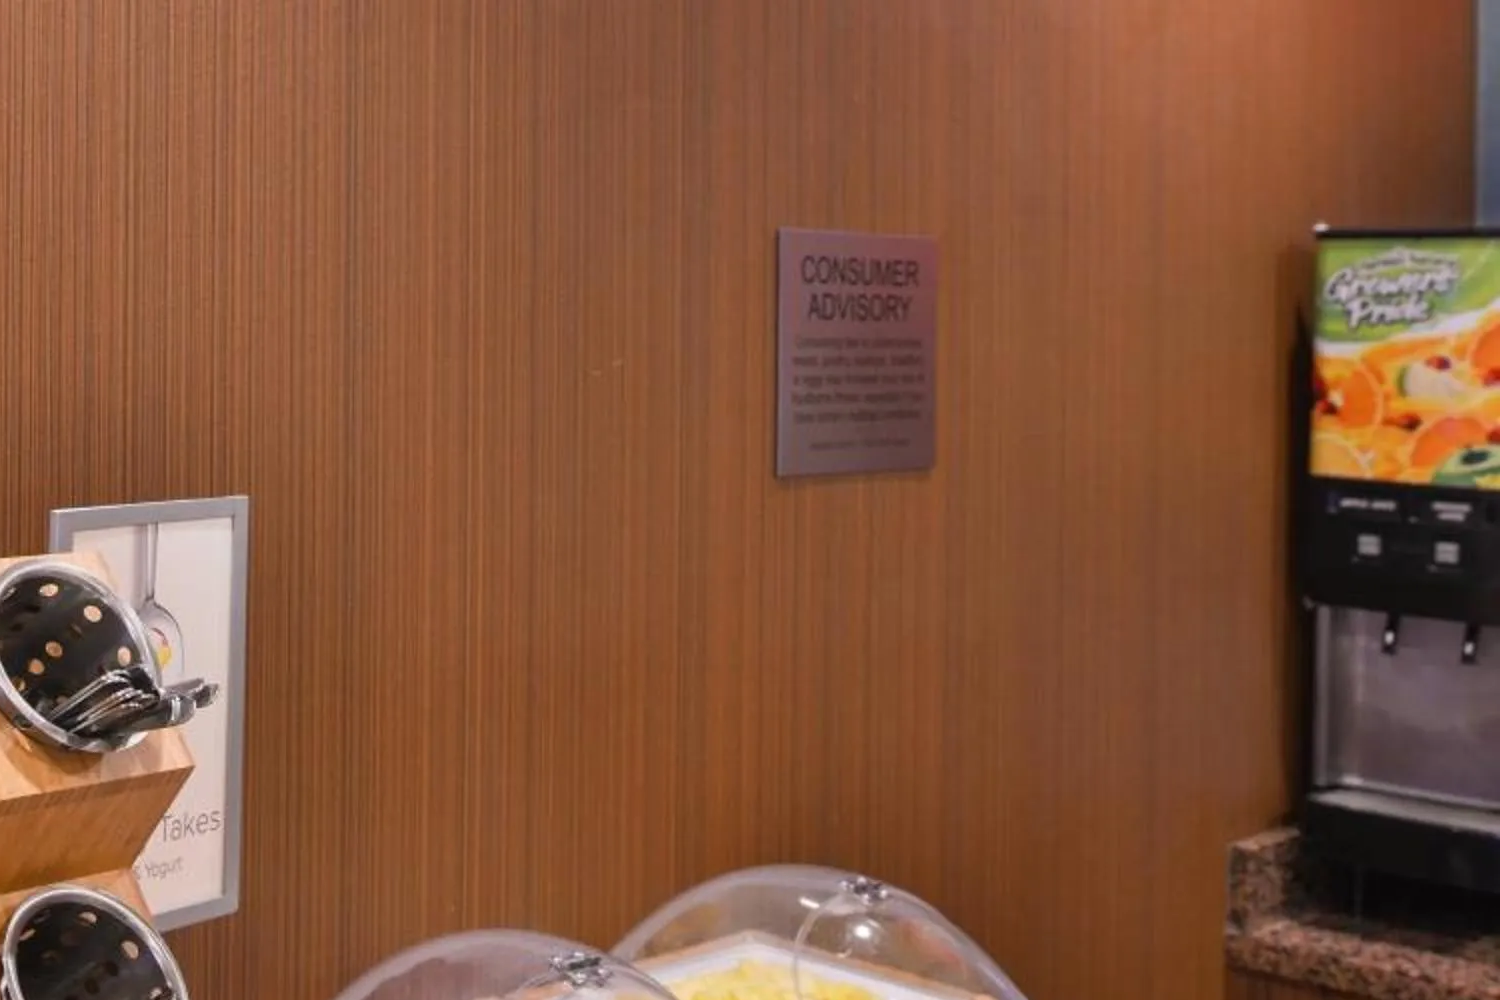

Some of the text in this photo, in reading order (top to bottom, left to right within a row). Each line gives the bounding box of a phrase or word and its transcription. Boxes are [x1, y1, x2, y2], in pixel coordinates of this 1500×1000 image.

[801, 255, 920, 287] CONSUMER
[808, 293, 911, 322] ADVISORY
[162, 810, 221, 842] Takes
[144, 856, 184, 880] Yogurt
